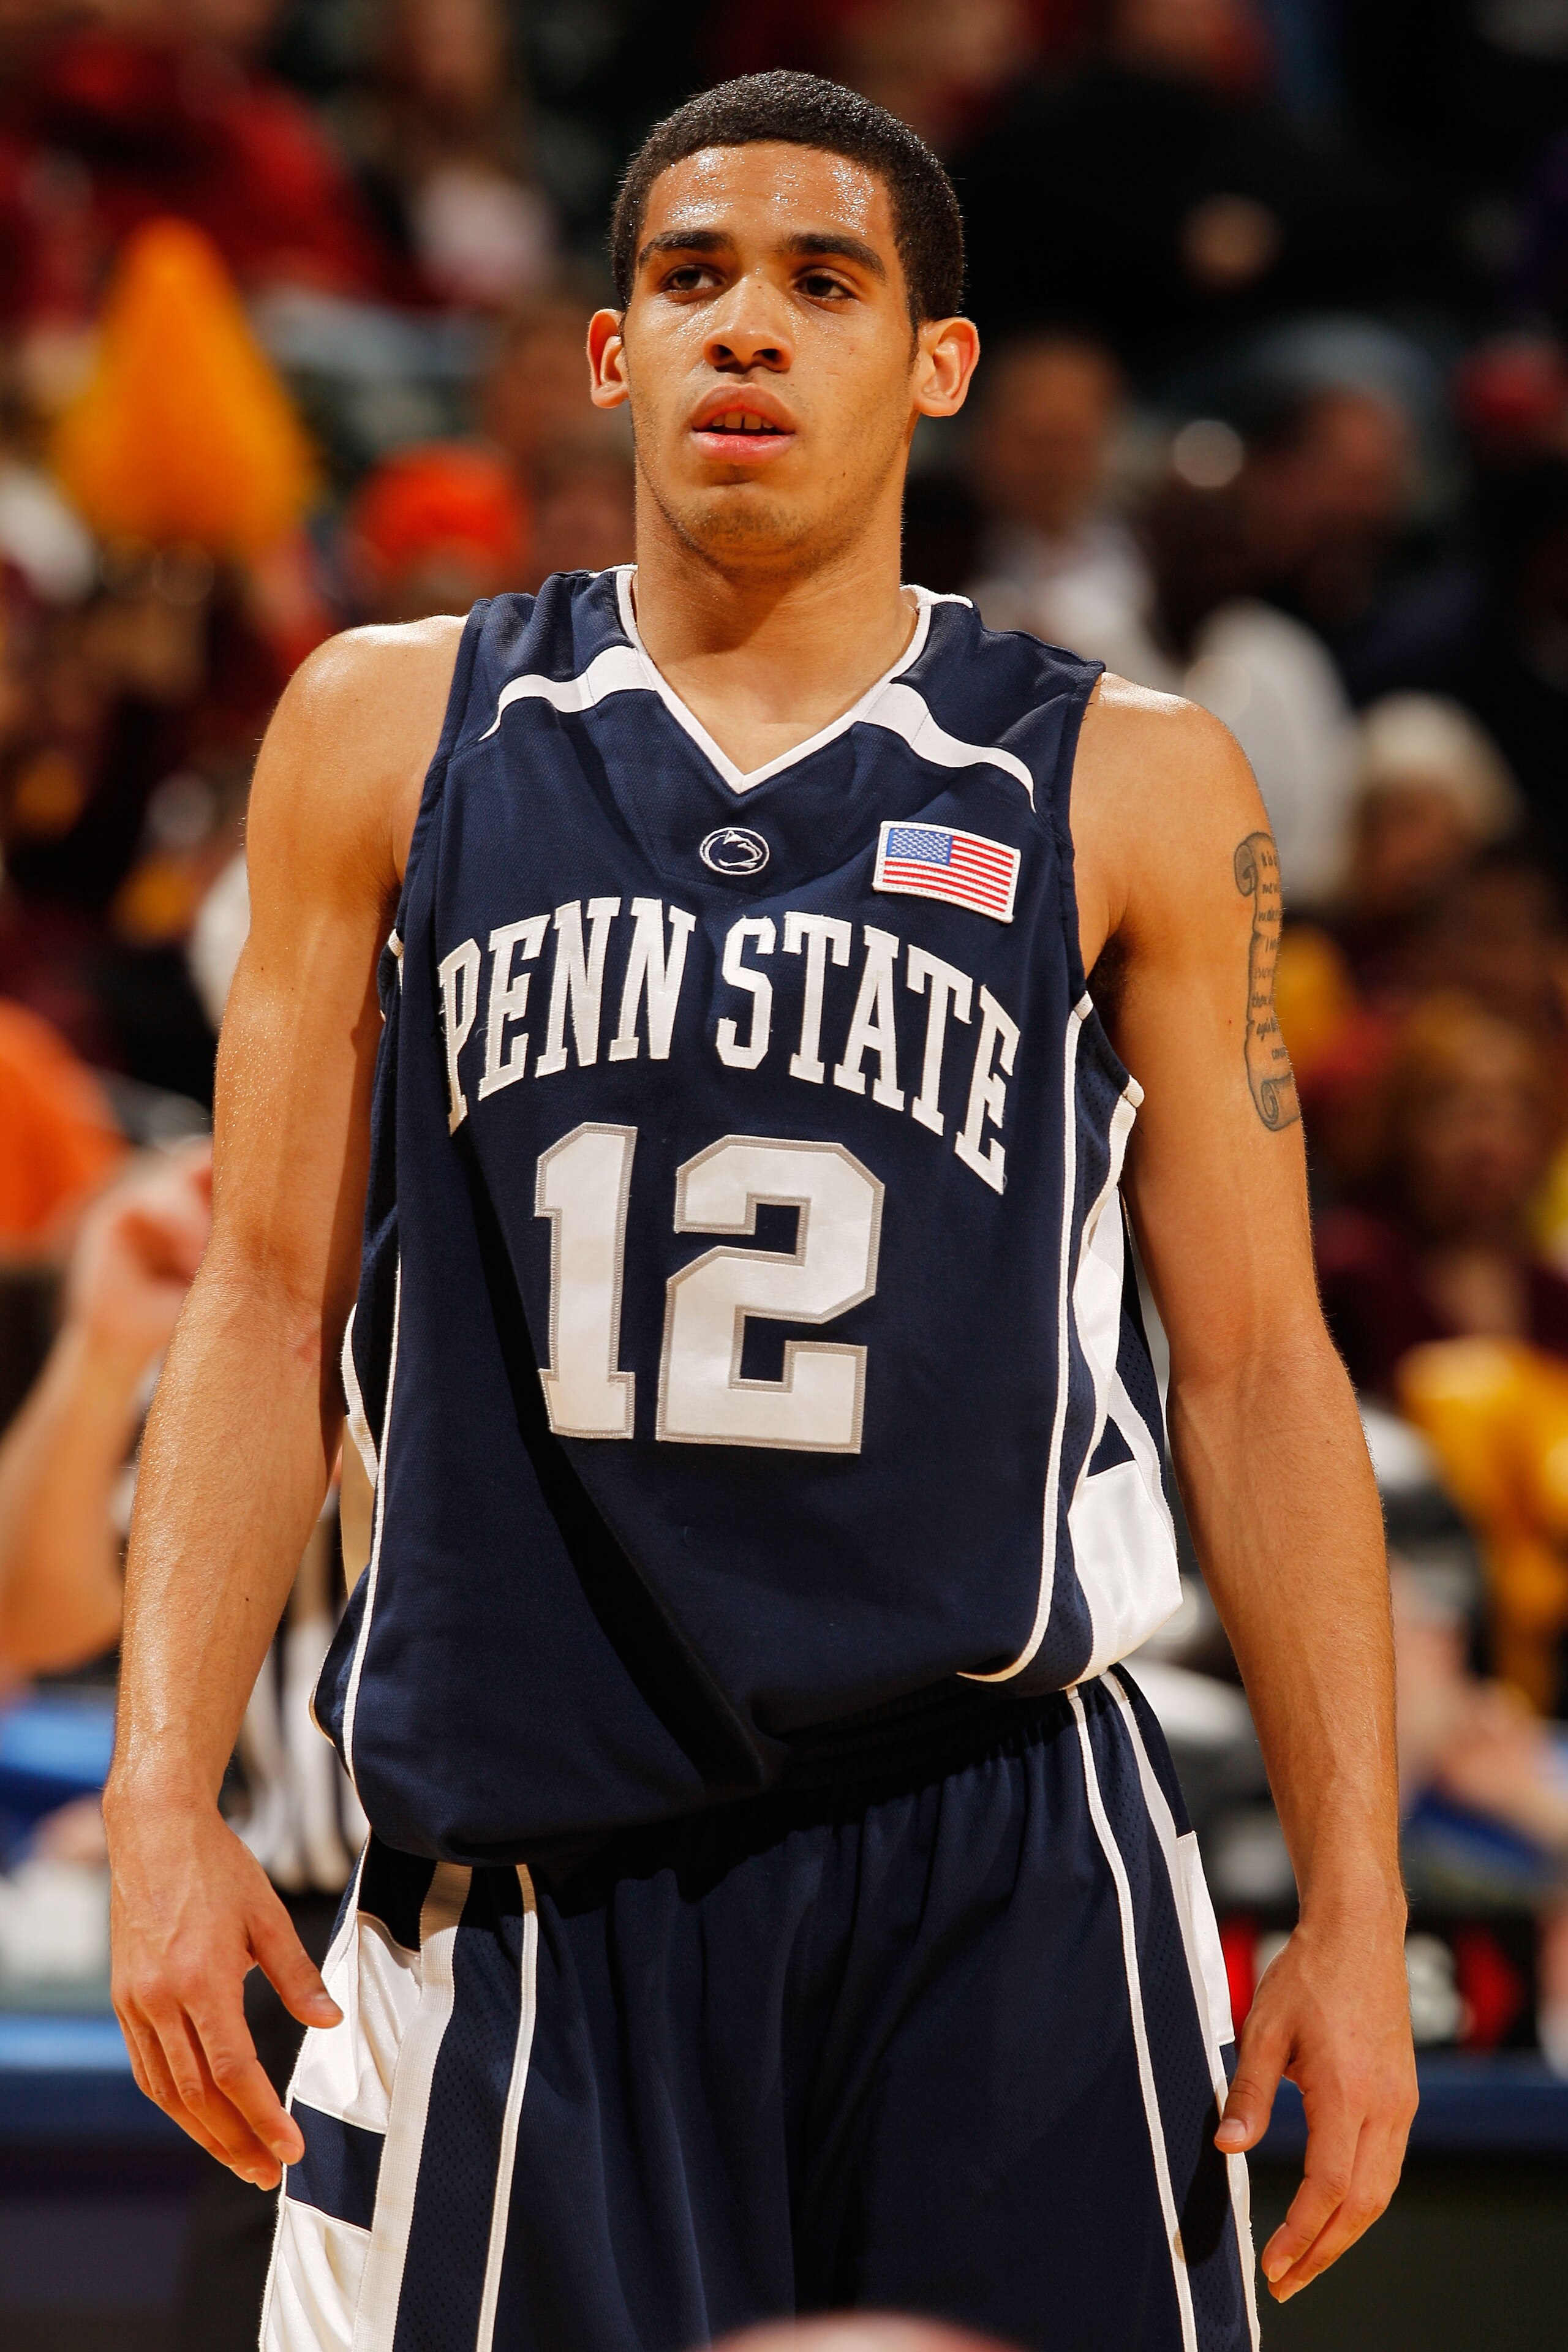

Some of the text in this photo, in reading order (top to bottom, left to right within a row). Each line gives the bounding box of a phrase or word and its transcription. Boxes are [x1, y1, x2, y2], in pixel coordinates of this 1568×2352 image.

[437, 896, 1021, 1195] PENN STATE
[534, 1121, 886, 1454] 12
